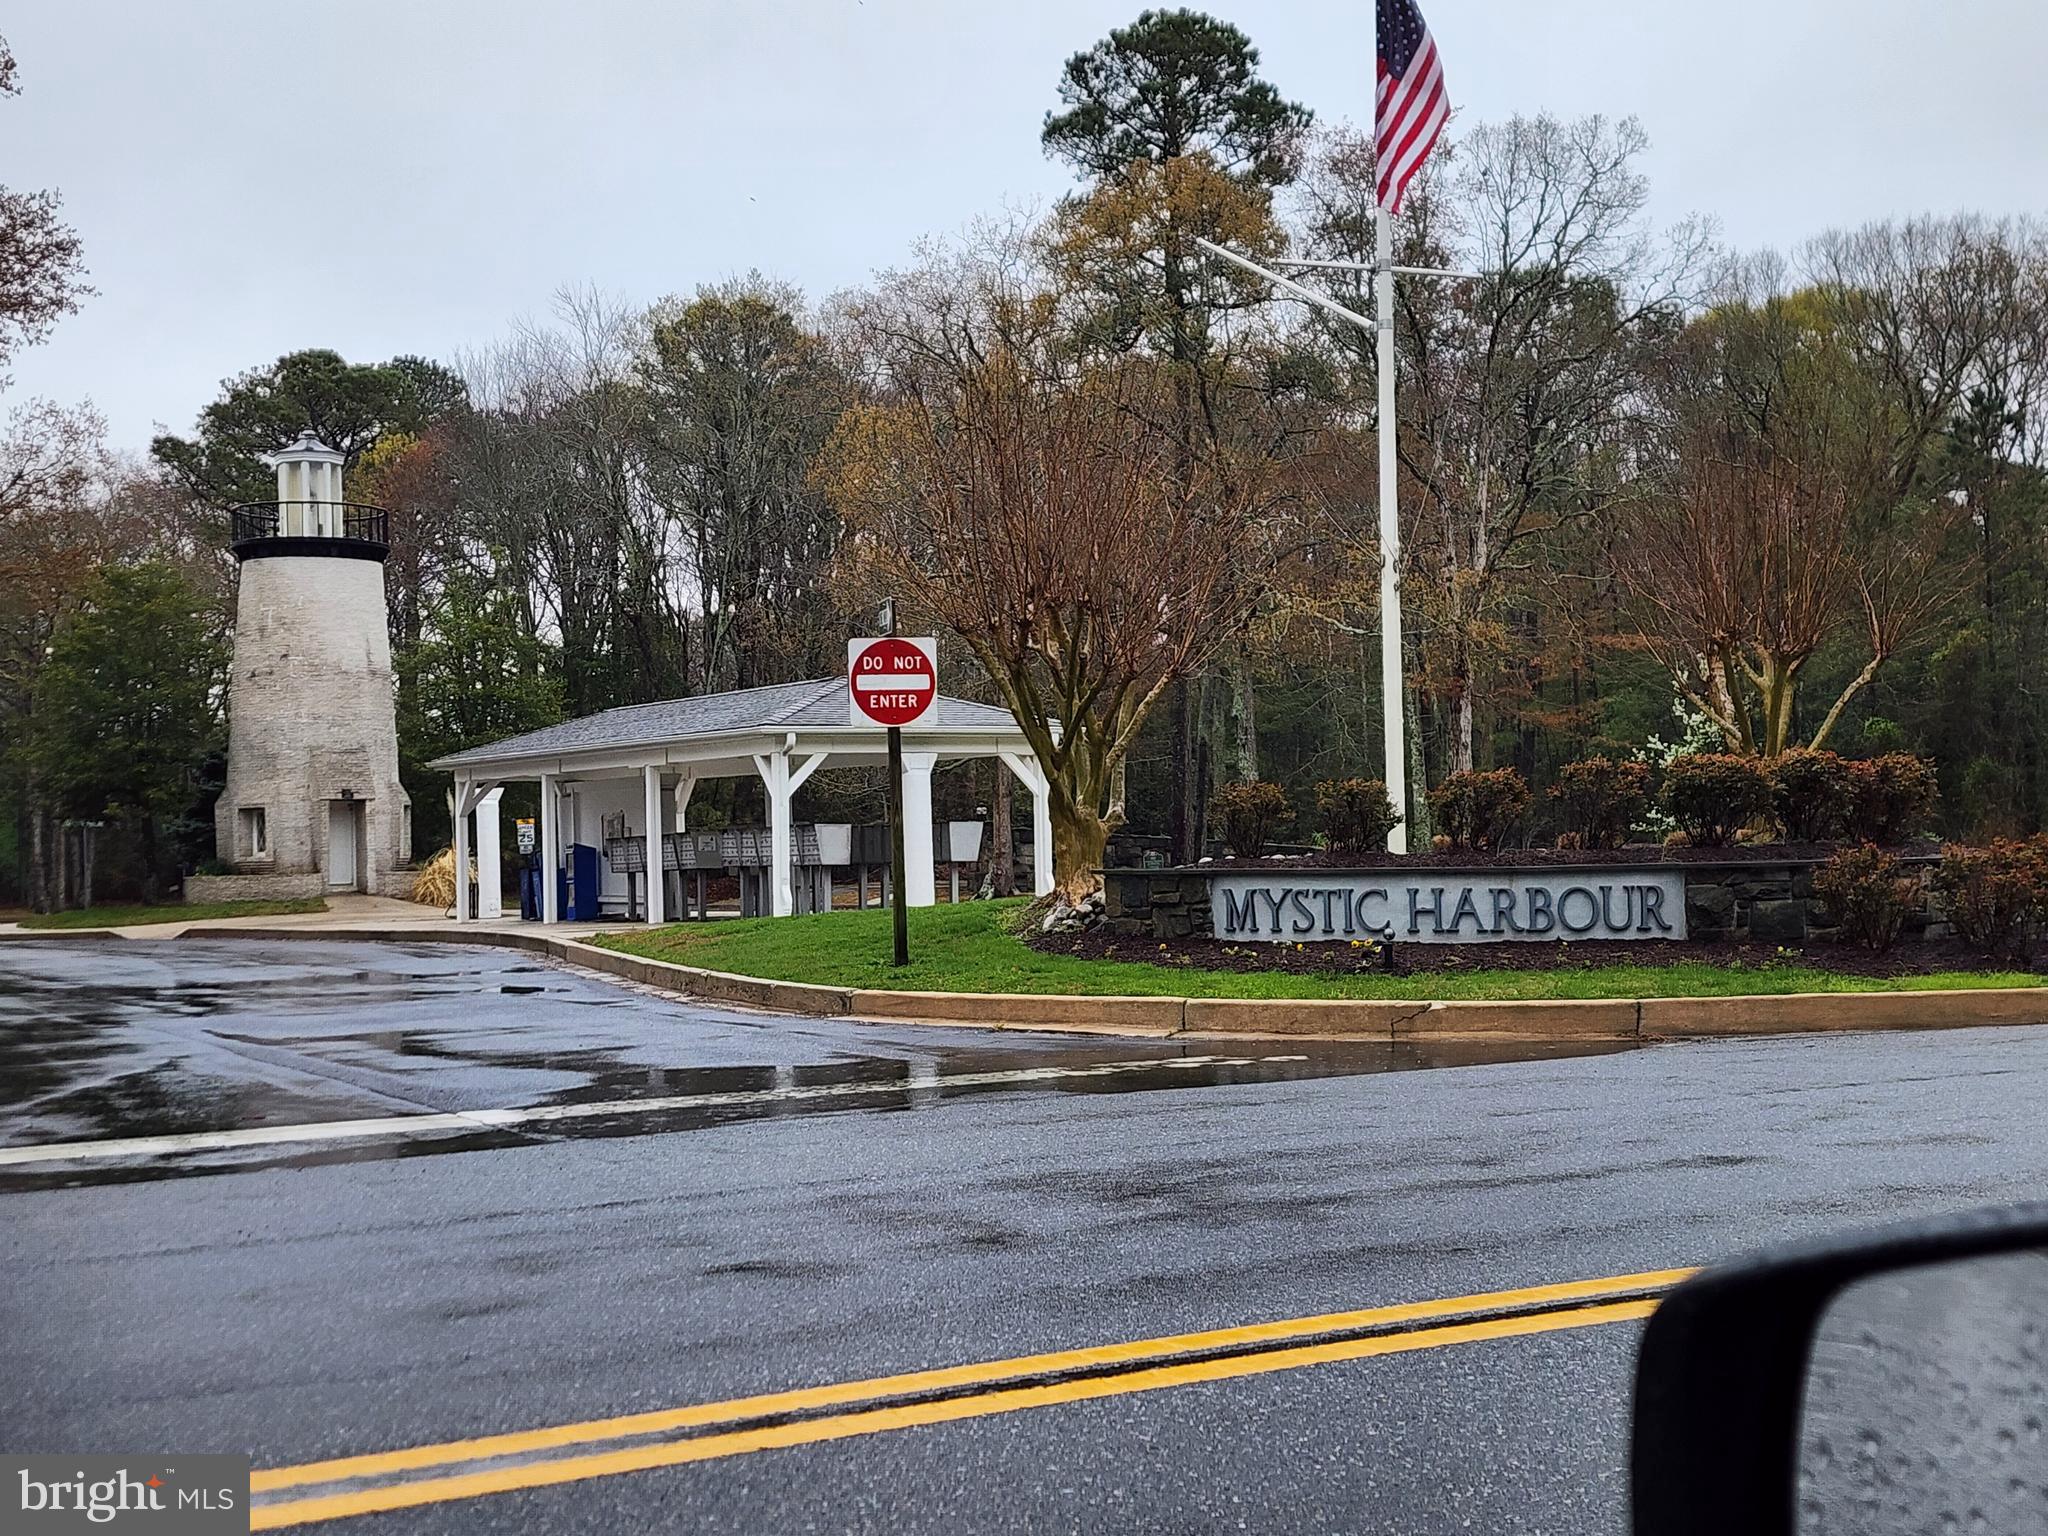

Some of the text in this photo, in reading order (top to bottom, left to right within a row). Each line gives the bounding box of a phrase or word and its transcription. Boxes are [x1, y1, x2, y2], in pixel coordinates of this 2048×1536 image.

[863, 656, 922, 670] DO NOT
[870, 694, 918, 708] ENTER
[519, 834, 533, 843] 25
[1221, 885, 1672, 933] MYSTIC HARBOUR
